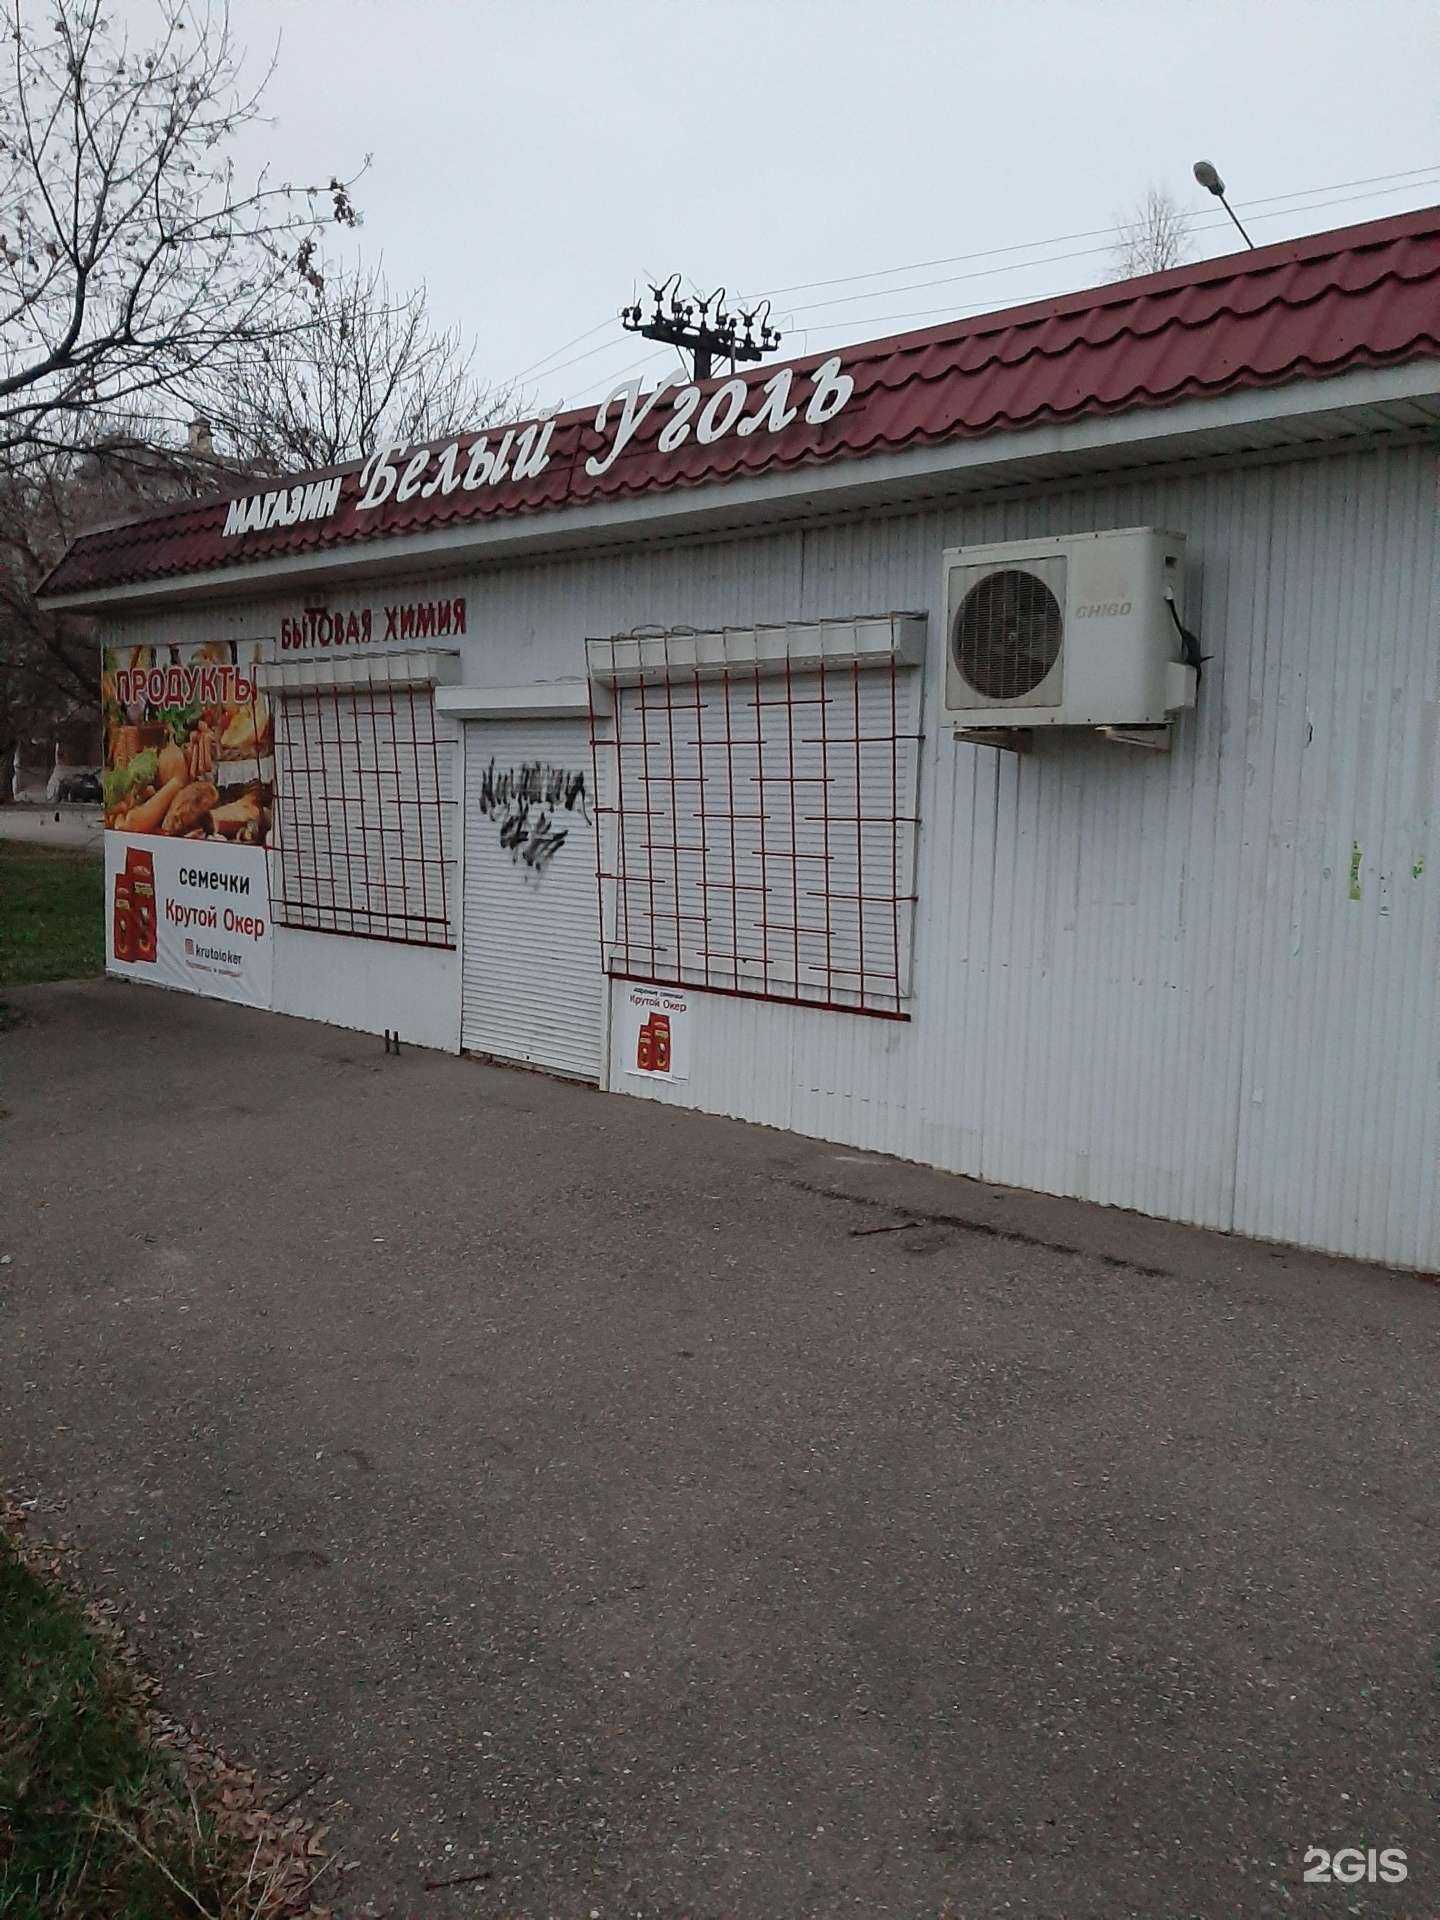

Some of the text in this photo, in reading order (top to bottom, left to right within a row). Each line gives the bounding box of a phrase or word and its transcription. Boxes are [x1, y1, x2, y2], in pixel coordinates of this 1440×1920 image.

[222, 356, 855, 537] МАГАЗИН Белый Уголь
[281, 598, 466, 649] БЫТОВАЯ ХИМИЯ
[115, 665, 258, 710] ПРОДУКТЫ
[179, 867, 250, 896] семечки
[165, 898, 265, 941] Крутой Окер
